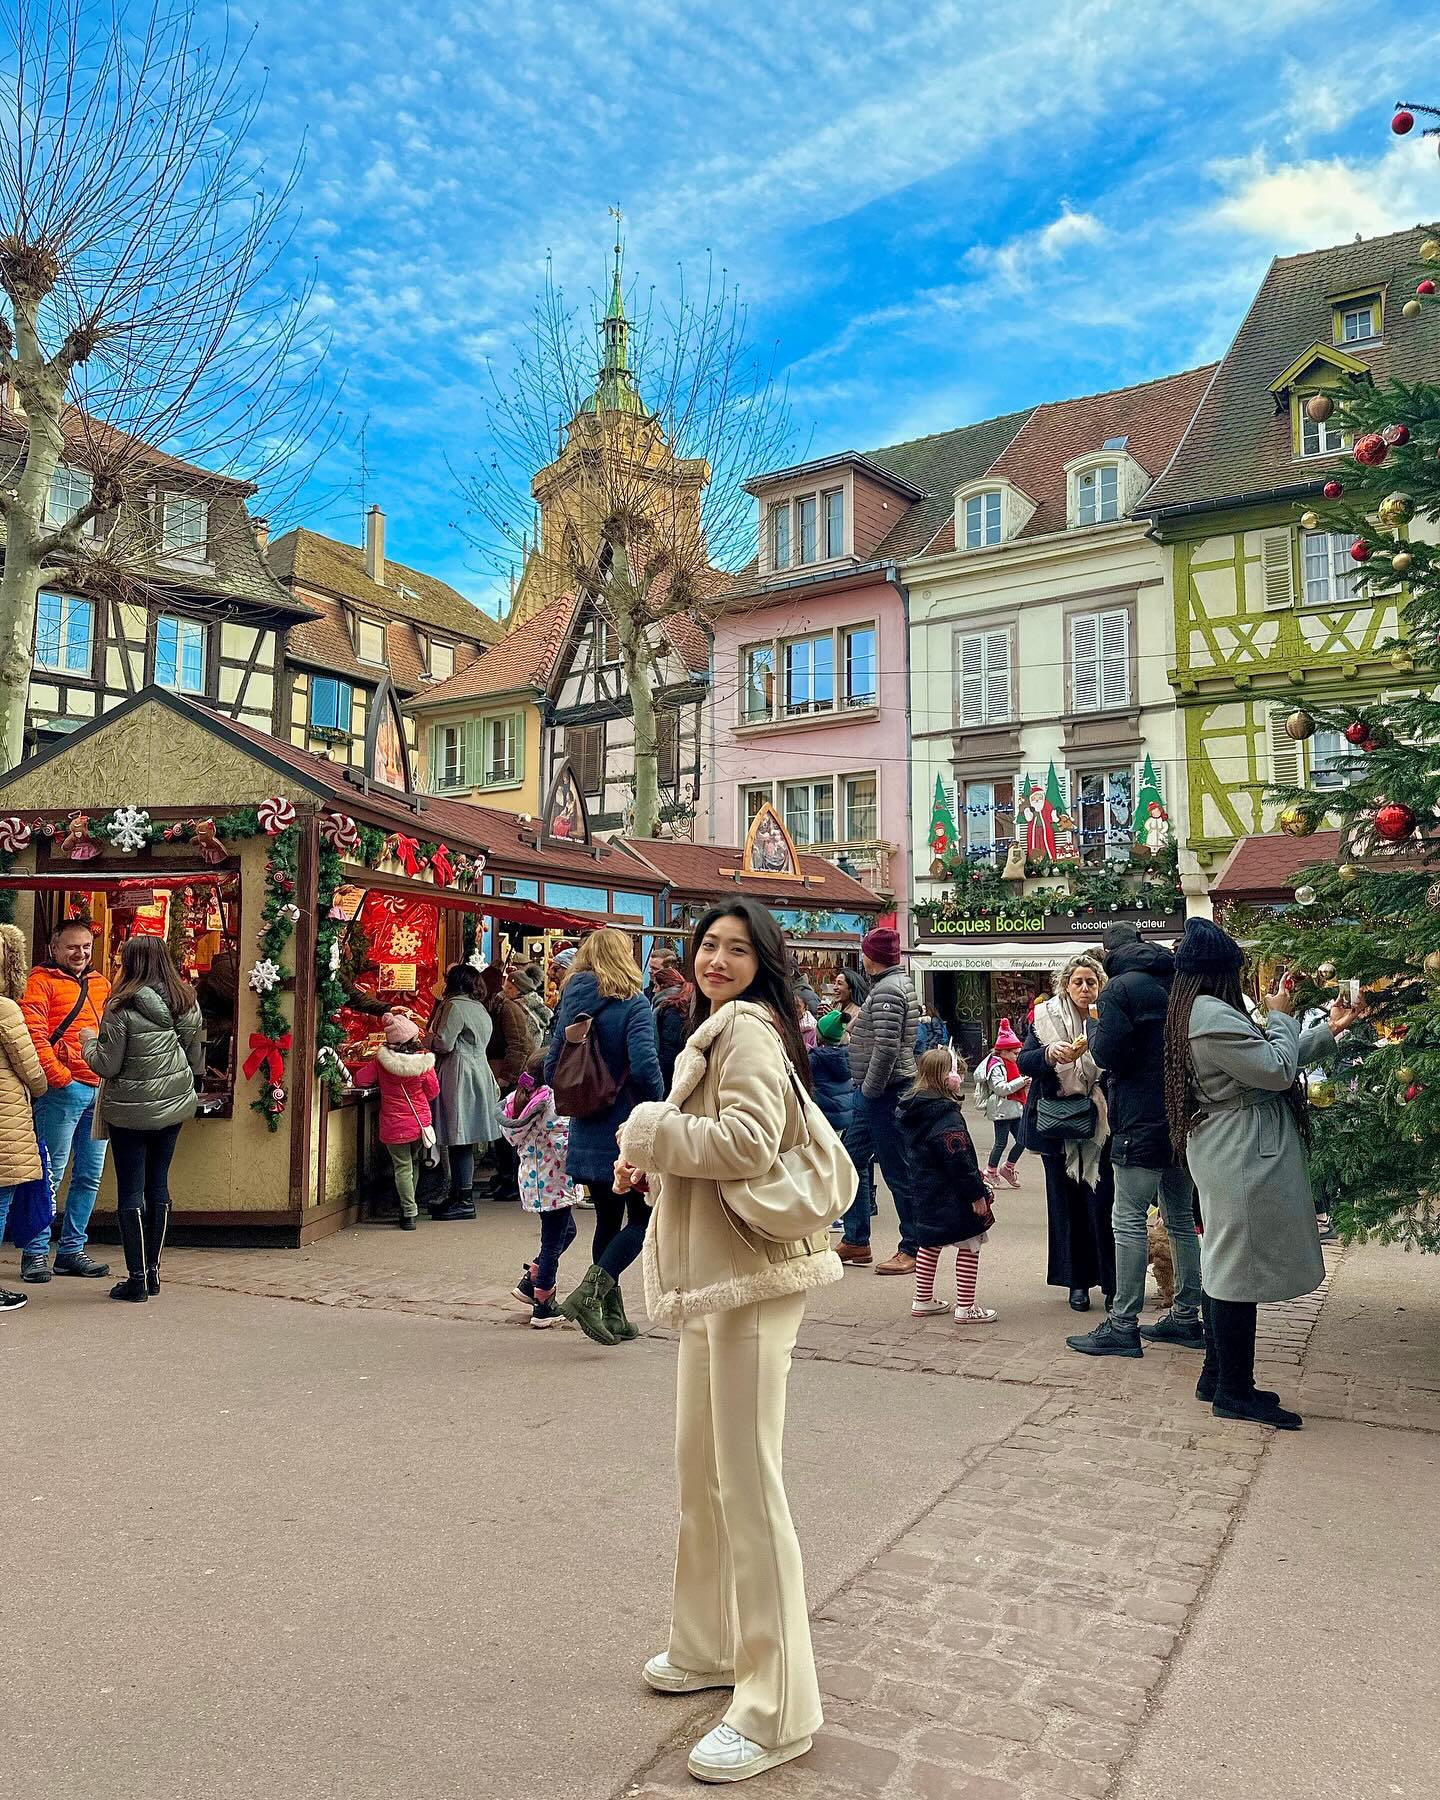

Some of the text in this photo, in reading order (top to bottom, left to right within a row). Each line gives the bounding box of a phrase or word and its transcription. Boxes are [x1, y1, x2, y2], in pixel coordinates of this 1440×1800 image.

[930, 915, 1045, 936] Jacques Bockel
[928, 958, 993, 969] Jacques Bockel
